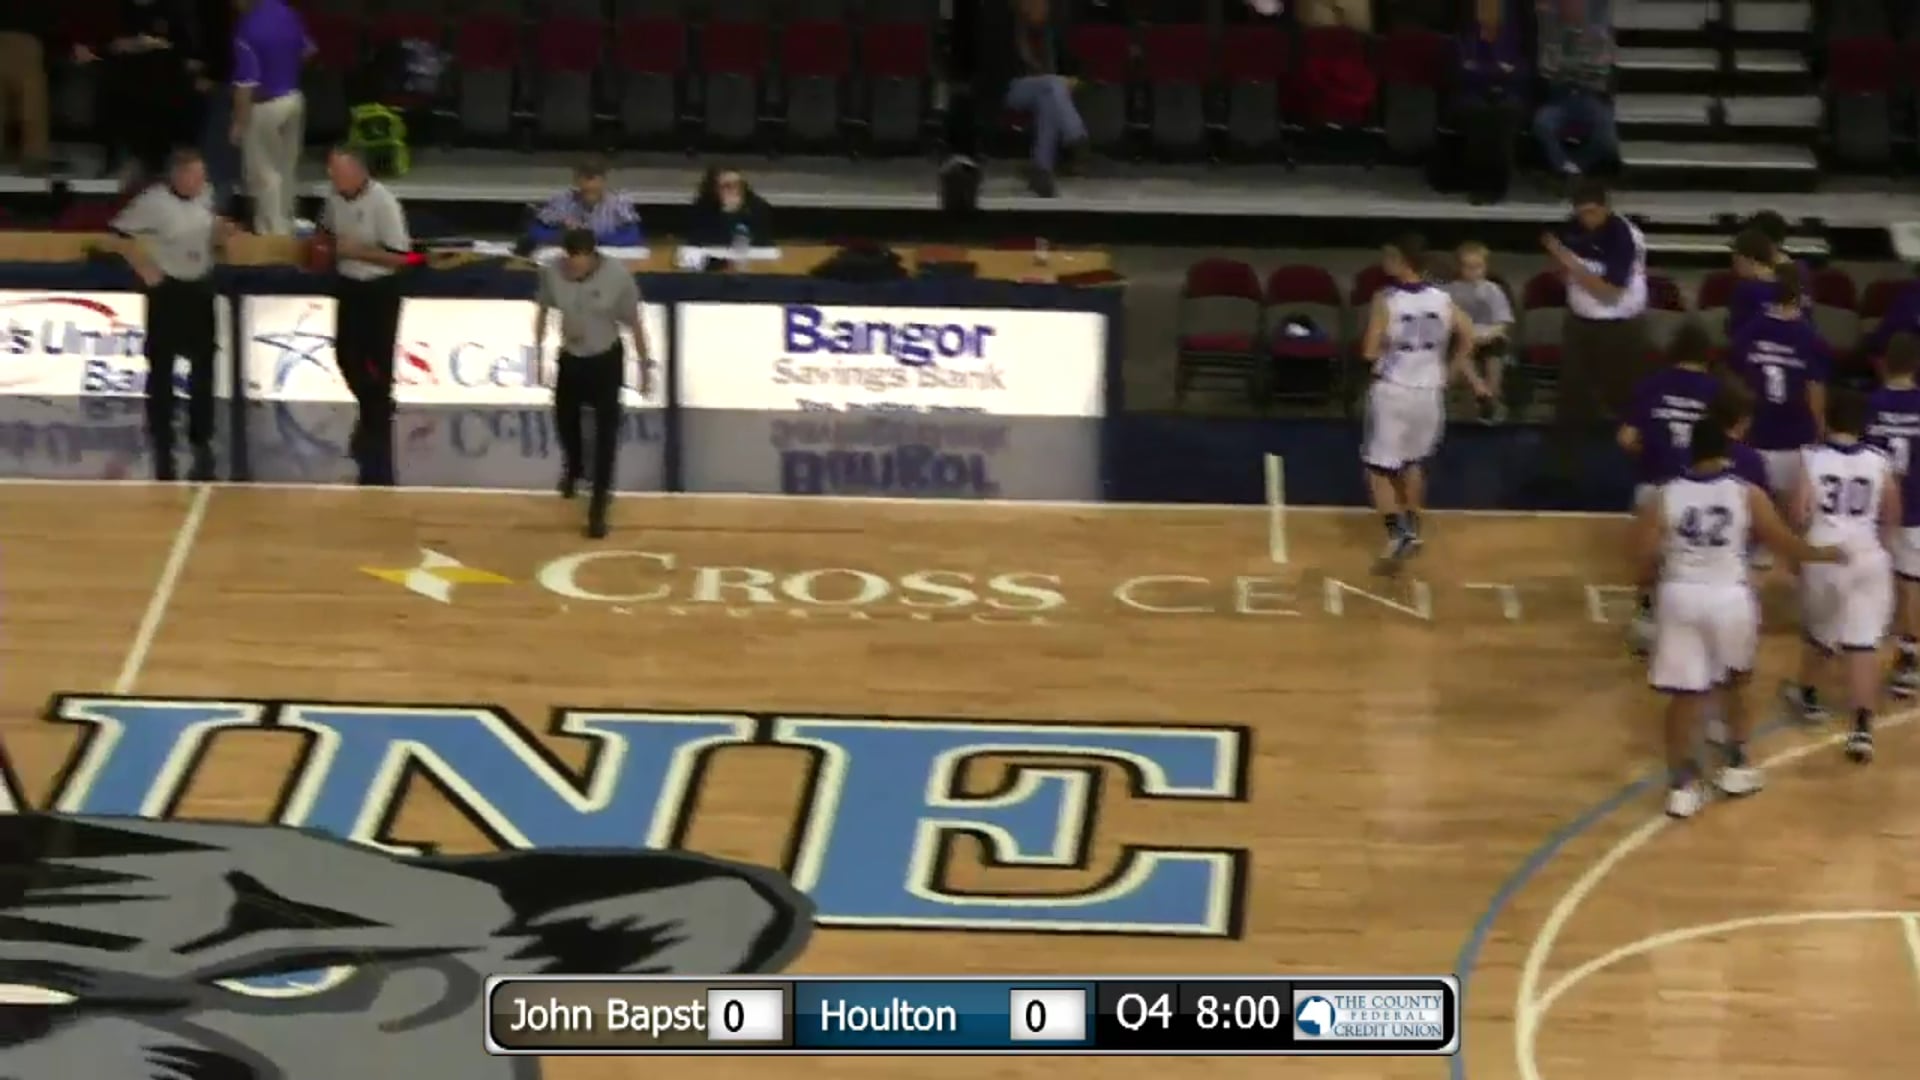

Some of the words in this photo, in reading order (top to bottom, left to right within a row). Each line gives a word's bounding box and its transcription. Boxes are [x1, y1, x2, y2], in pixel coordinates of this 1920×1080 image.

[782, 305, 996, 366] Bangor
[772, 357, 908, 392] Savings
[916, 362, 1007, 390] Bank
[1677, 505, 1733, 548] 42
[538, 550, 1066, 610] CROSS
[1113, 574, 1640, 624] CENTE
